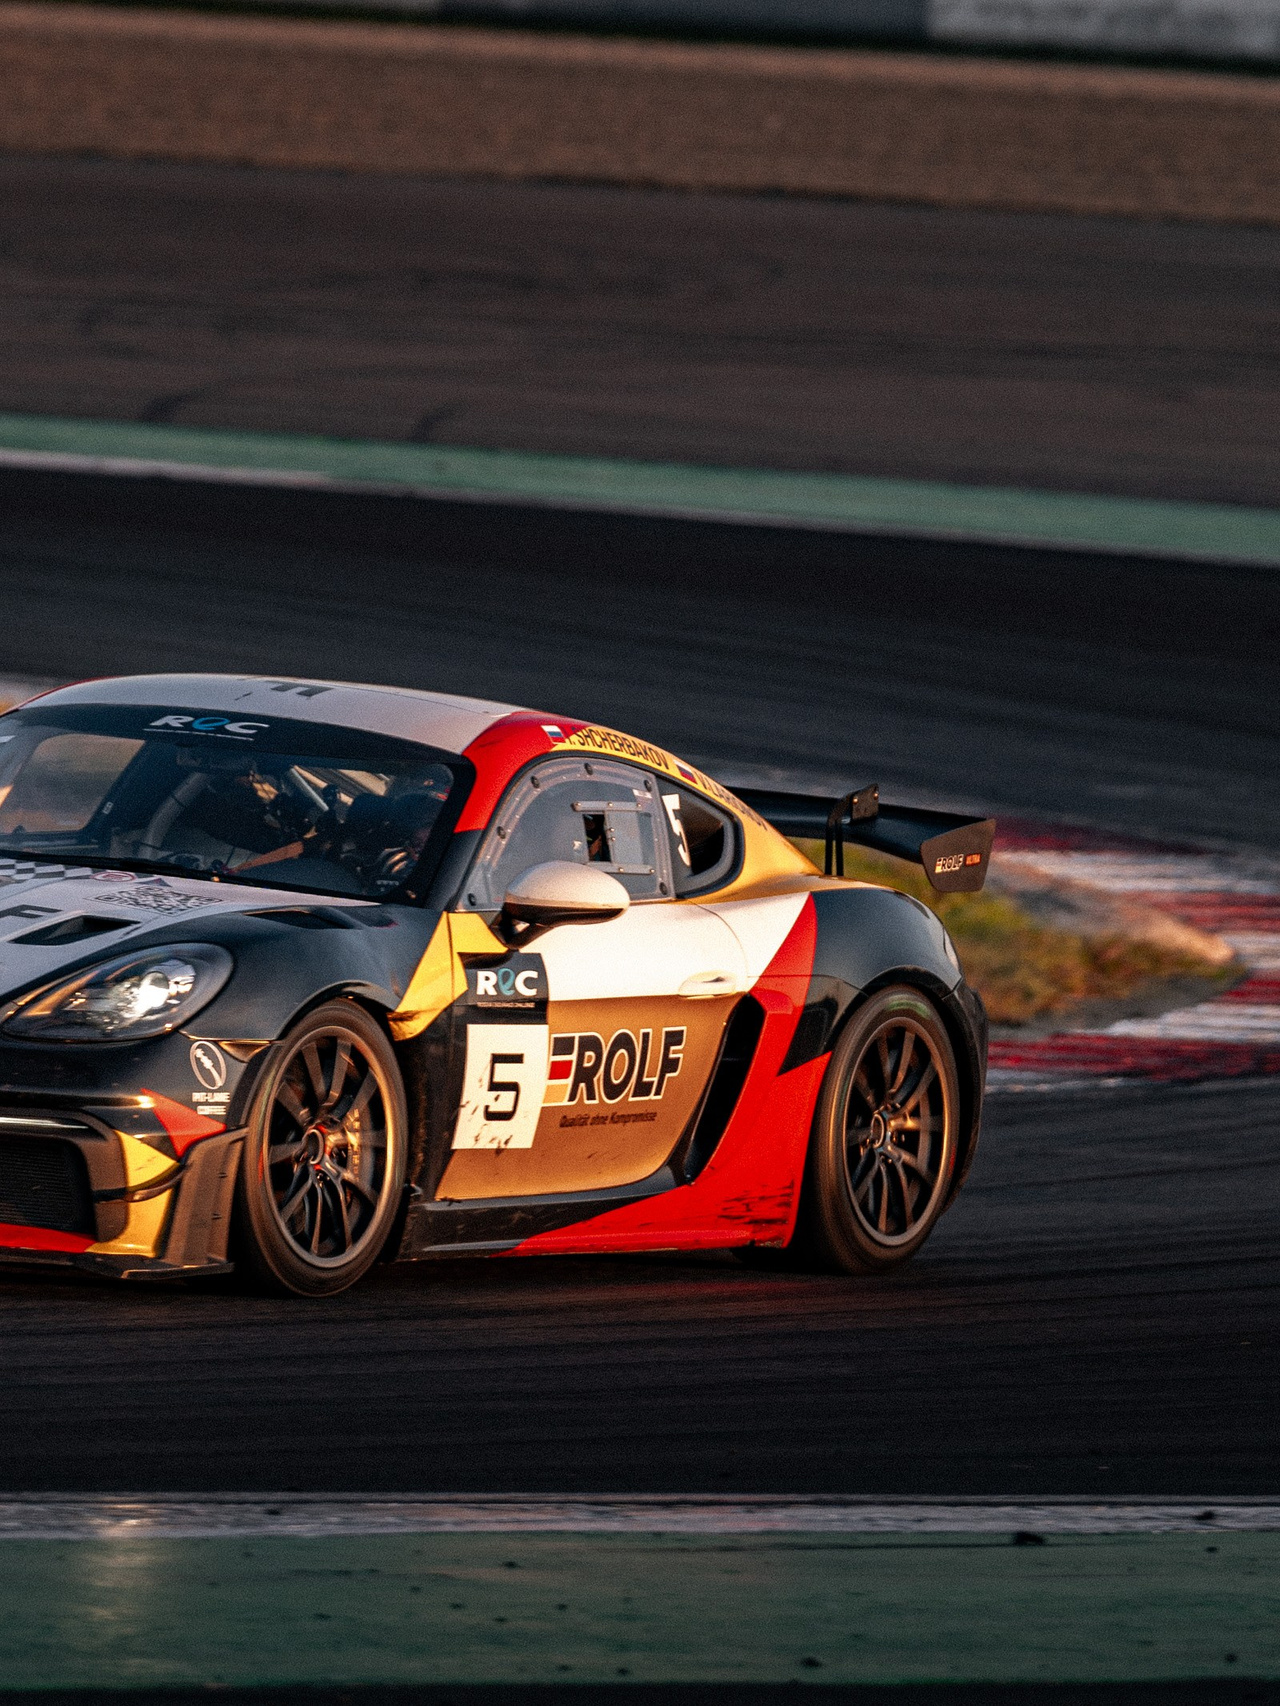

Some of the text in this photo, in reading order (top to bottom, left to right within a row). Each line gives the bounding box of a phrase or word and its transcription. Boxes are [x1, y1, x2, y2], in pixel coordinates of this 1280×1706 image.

[573, 726, 670, 770] SHCHERBAKOV
[661, 793, 692, 867] 5
[939, 854, 964, 872] ROLF
[484, 1053, 524, 1121] 5
[566, 1026, 687, 1104] ROLF
